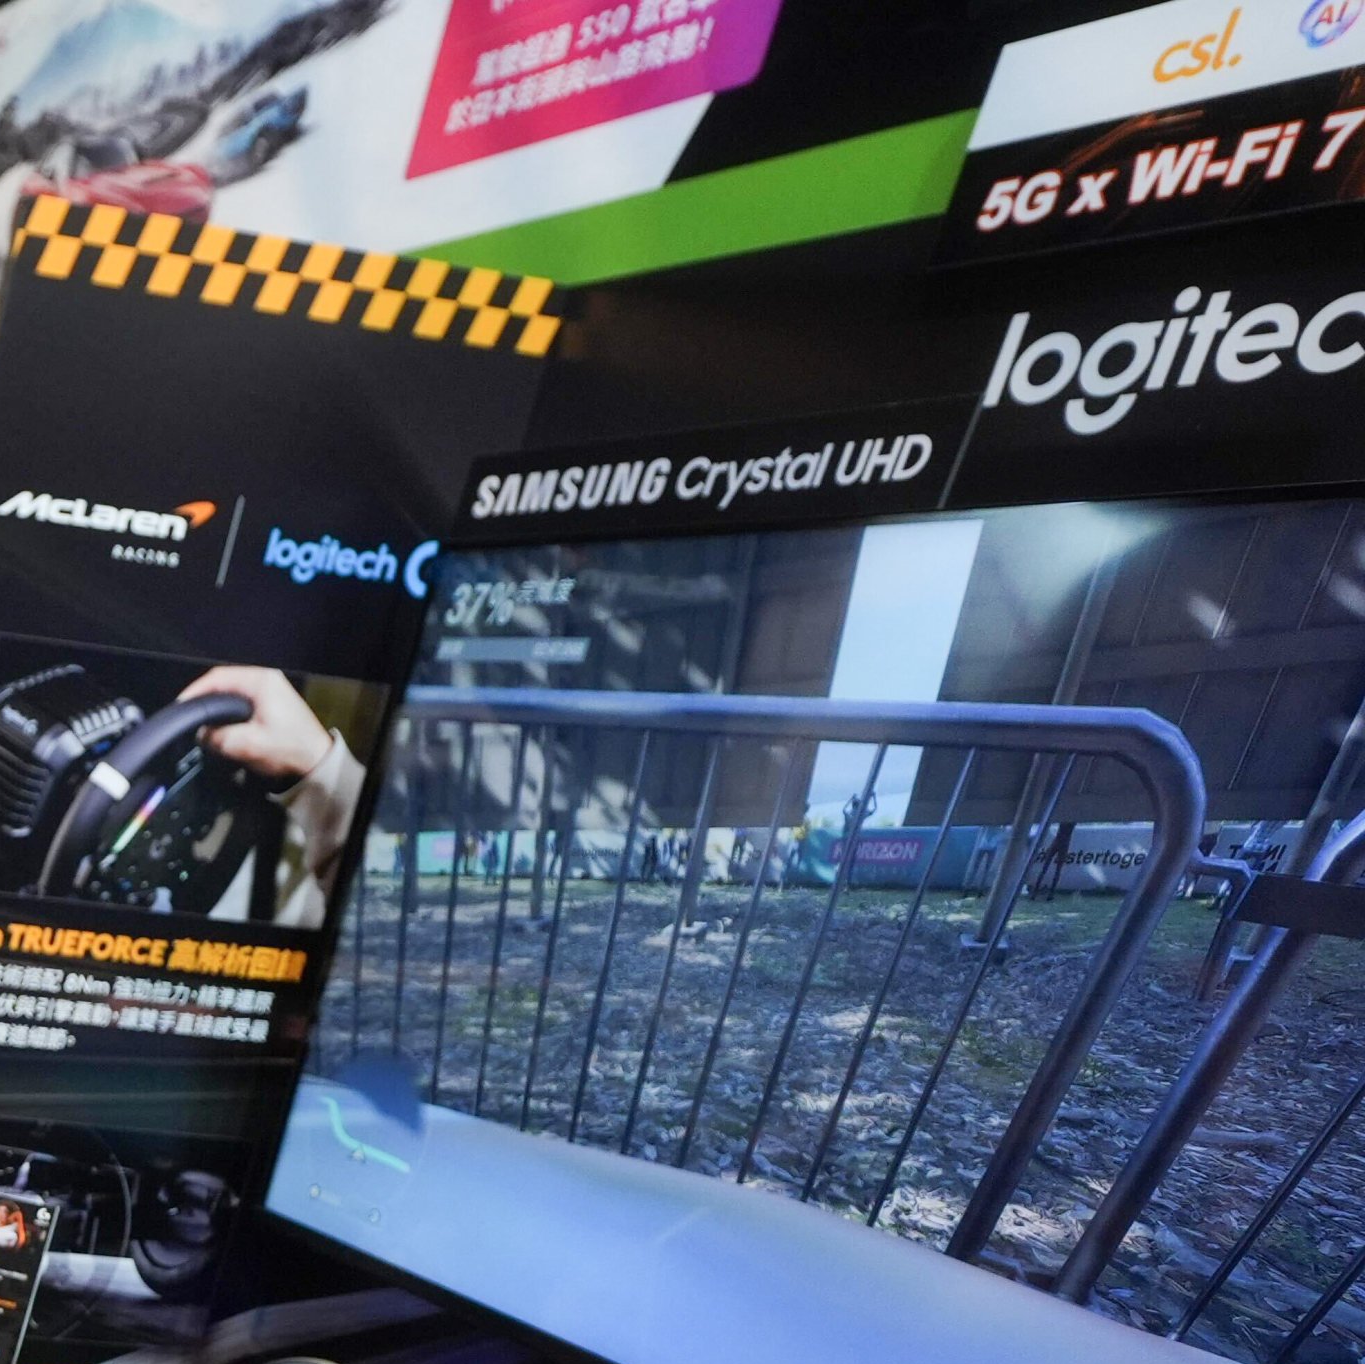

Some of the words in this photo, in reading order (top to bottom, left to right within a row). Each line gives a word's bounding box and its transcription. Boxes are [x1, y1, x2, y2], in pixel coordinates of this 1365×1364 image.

[1152, 8, 1243, 84] csl.
[976, 169, 1063, 232] 5G
[1067, 168, 1118, 215] x
[1128, 118, 1305, 205] Wi-Fi
[1313, 105, 1365, 171] 7
[471, 457, 671, 519] SAMSUNG
[675, 442, 835, 511] Crystal
[834, 433, 933, 486] UHD
[264, 527, 398, 584] logitech
[7, 923, 168, 966] TRUEFORCE
